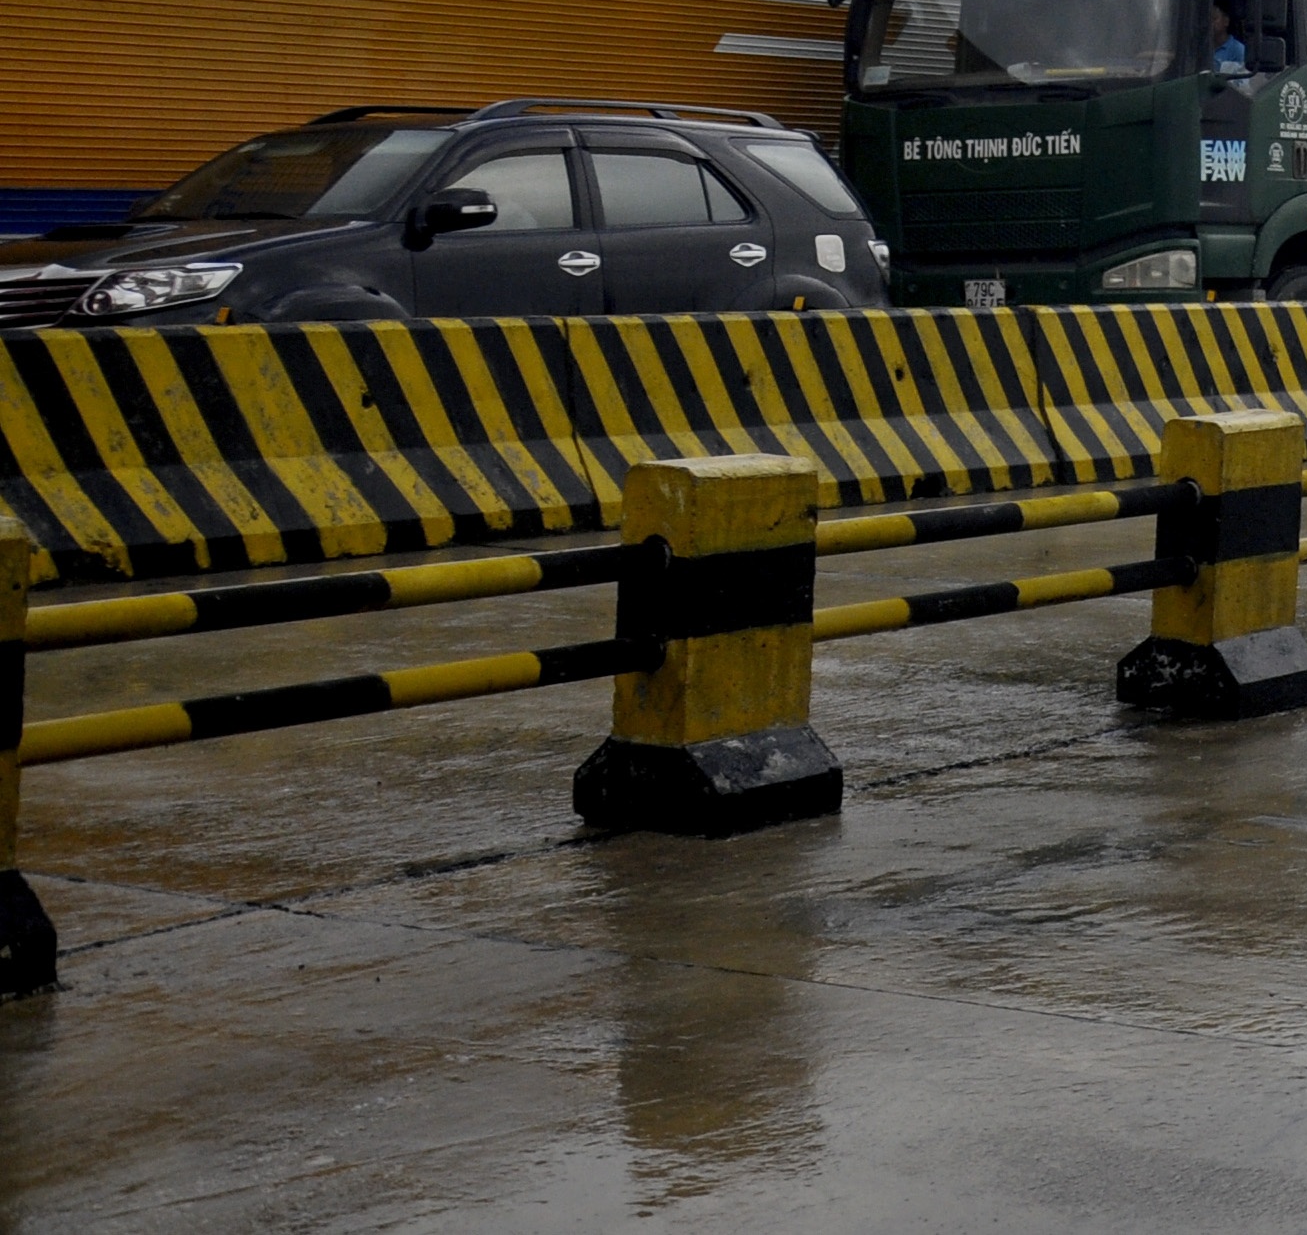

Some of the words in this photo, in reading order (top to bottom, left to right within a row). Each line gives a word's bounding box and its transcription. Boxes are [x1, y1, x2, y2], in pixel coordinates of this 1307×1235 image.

[903, 136, 921, 160] BÊ
[925, 136, 962, 159] TÔNG
[965, 138, 1008, 163] THỊNH
[1012, 131, 1042, 156] ĐỨC
[1045, 128, 1081, 154] TIẾN
[1200, 163, 1247, 182] FAW
[973, 282, 995, 297] 79C
